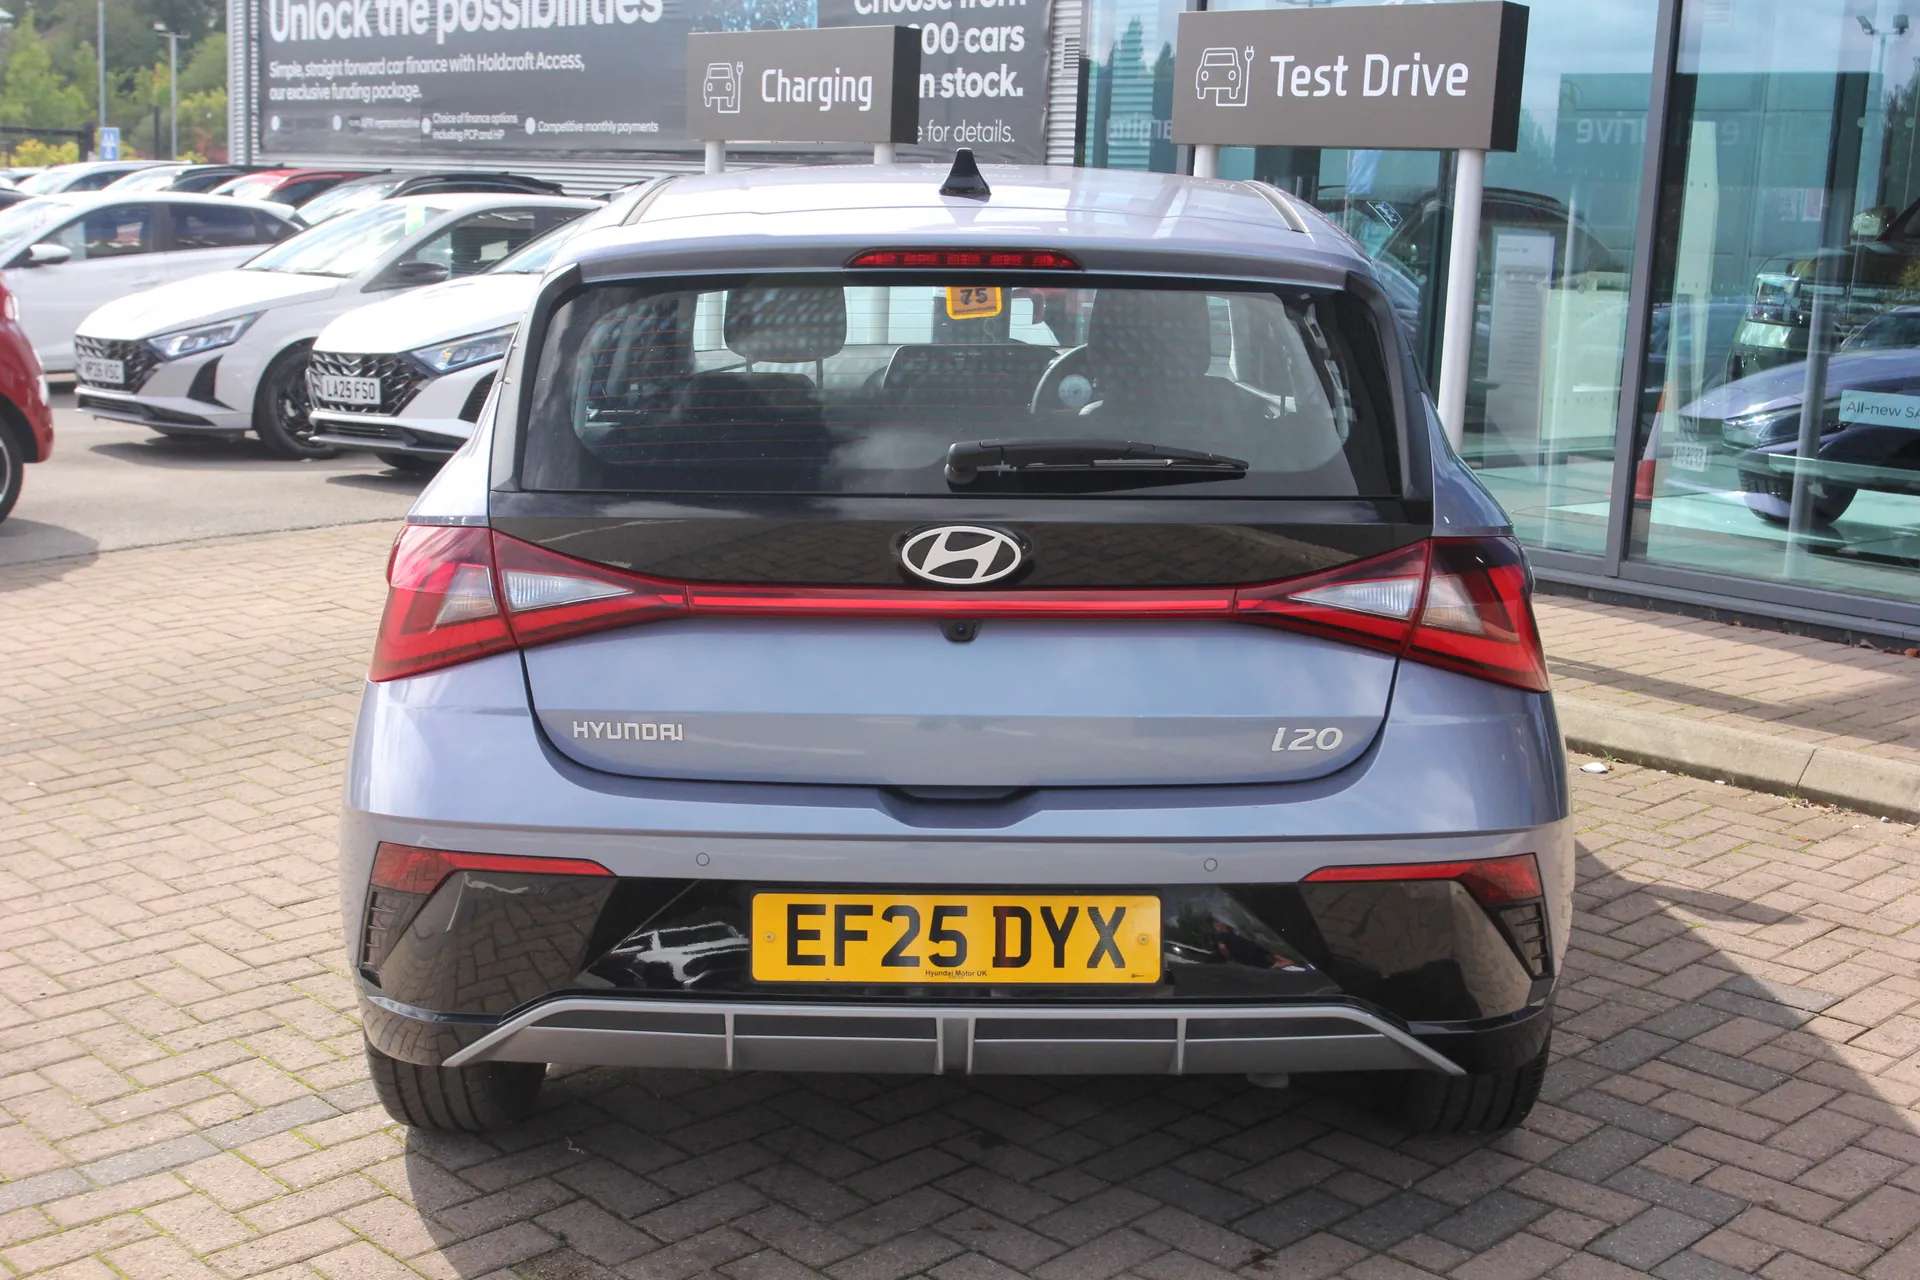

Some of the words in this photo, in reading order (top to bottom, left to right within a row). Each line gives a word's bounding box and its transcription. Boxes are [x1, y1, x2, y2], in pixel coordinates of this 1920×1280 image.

[269, 0, 372, 42] Unlock
[375, 0, 430, 37] the
[436, 0, 663, 45] possibilities
[908, 22, 959, 55] 00
[963, 25, 1025, 53] cars
[268, 60, 304, 80] Simple,
[305, 59, 343, 80] straight
[343, 57, 386, 76] forward
[386, 60, 404, 75] car
[405, 56, 448, 74] finance
[450, 54, 476, 72] with
[477, 51, 536, 72] Holdcroft
[535, 52, 585, 72] Access,
[1269, 55, 1349, 97] Test
[1362, 52, 1469, 97] Drive
[268, 86, 286, 101] our
[286, 83, 331, 101] exclusive
[331, 82, 371, 103] funding
[371, 81, 424, 103] package.
[761, 67, 873, 112] Charging
[940, 63, 1024, 98] stock.
[584, 120, 617, 135] monthly
[617, 121, 659, 135] payments
[927, 119, 951, 142] for
[953, 119, 1016, 143] details.
[960, 287, 988, 305] 75
[1846, 400, 1902, 417] All-new
[573, 721, 683, 741] HYUNDAI
[786, 904, 968, 968] EF25
[992, 905, 1127, 968] DYX
[925, 968, 953, 977] Hyundai
[955, 969, 975, 977] Motor
